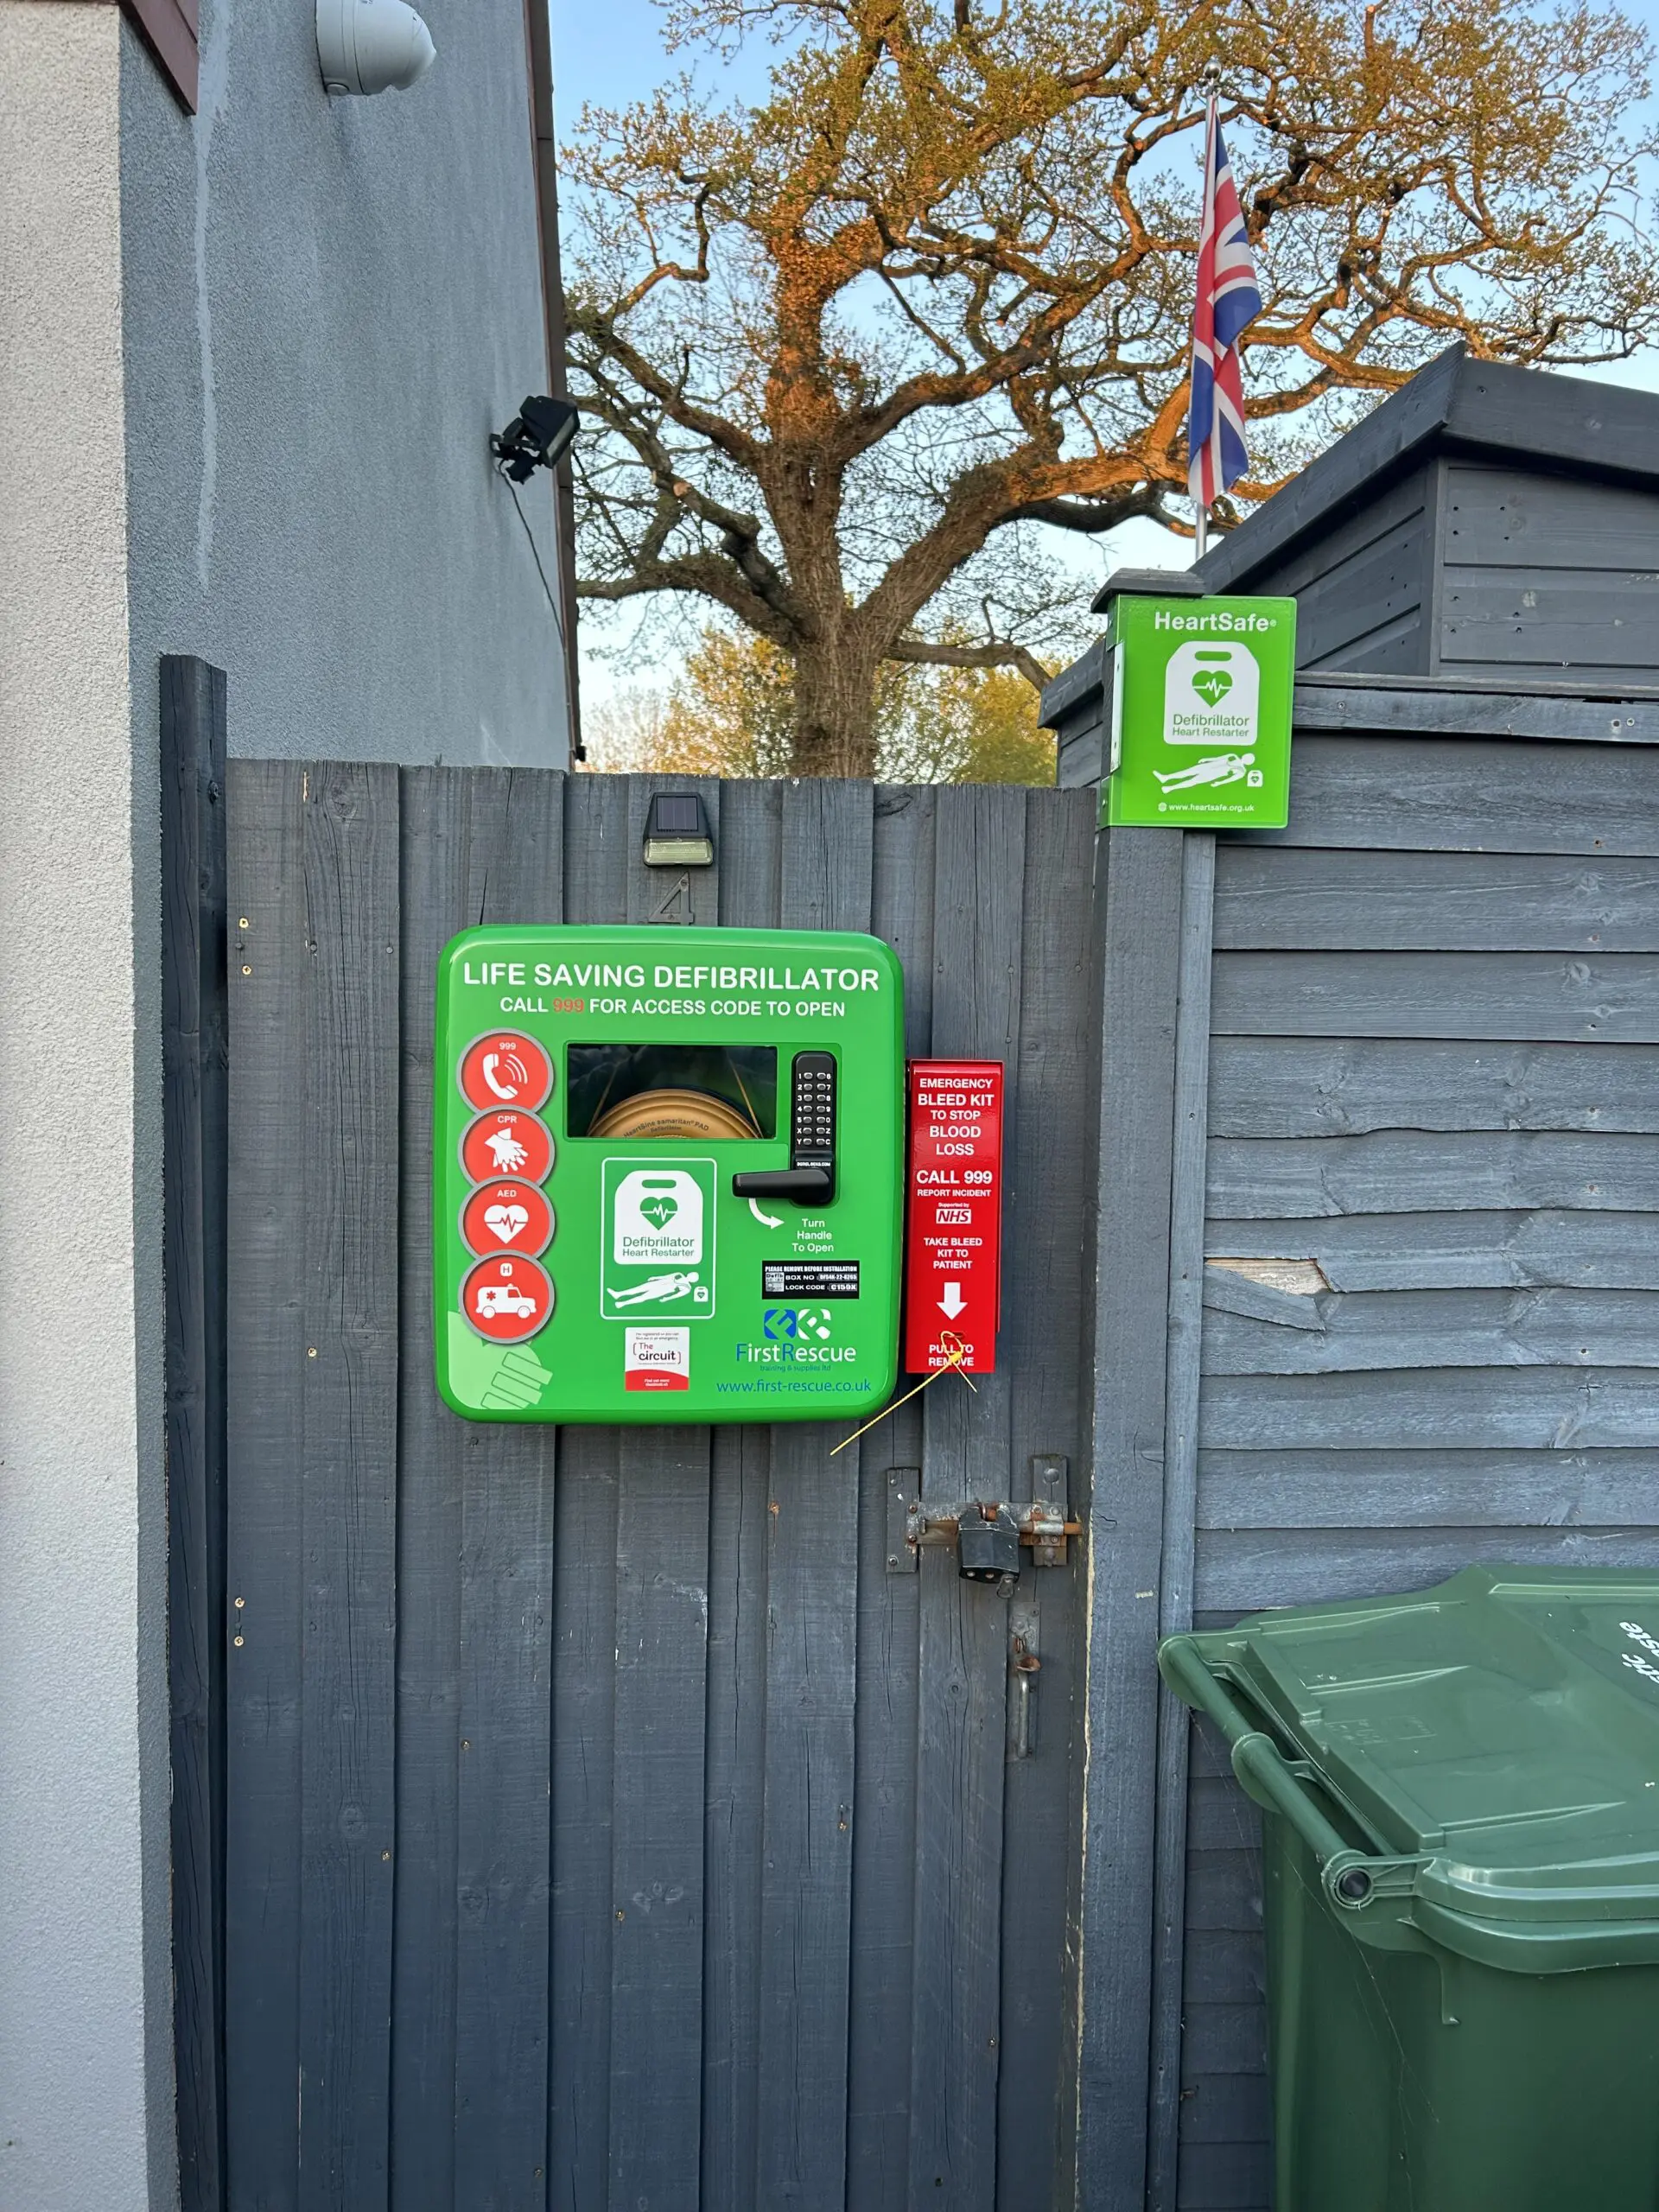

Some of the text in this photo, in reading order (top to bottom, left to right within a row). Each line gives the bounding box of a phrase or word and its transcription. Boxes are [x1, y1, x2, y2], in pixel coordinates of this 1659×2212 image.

[1173, 714, 1249, 726] Defibrillator
[1173, 727, 1249, 737] Heart Restarter
[1168, 803, 1255, 813] www.heartsafe.org.uk
[463, 962, 879, 991] LIFE SAVING DEFIBRILLATOR
[499, 996, 845, 1017] CALL 999 FOR ACCESS CODE TO OPEN
[919, 1077, 993, 1089] EMERGENCY
[918, 1093, 995, 1106] BLEED KIT
[931, 1109, 982, 1121] TO STOP
[695, 1121, 709, 1131] PAD
[930, 1125, 982, 1138] BLOOD
[936, 1143, 975, 1156] LOSS
[916, 1170, 993, 1185] CALL 999
[497, 1189, 517, 1198] AED
[938, 1211, 969, 1222] NHS
[802, 1218, 825, 1227] Turn
[797, 1230, 832, 1240] Handle
[622, 1236, 695, 1247] Defibrillator
[924, 1237, 982, 1246] TAKE BLEED
[622, 1248, 649, 1256] Heart
[791, 1243, 834, 1253] To Open
[938, 1249, 969, 1257] KIT TO
[933, 1260, 973, 1269] PATIENT
[639, 1351, 677, 1361] circuit
[736, 1343, 857, 1363] FirstRescue
[716, 1379, 871, 1393] www.first-rescue.co.uk
